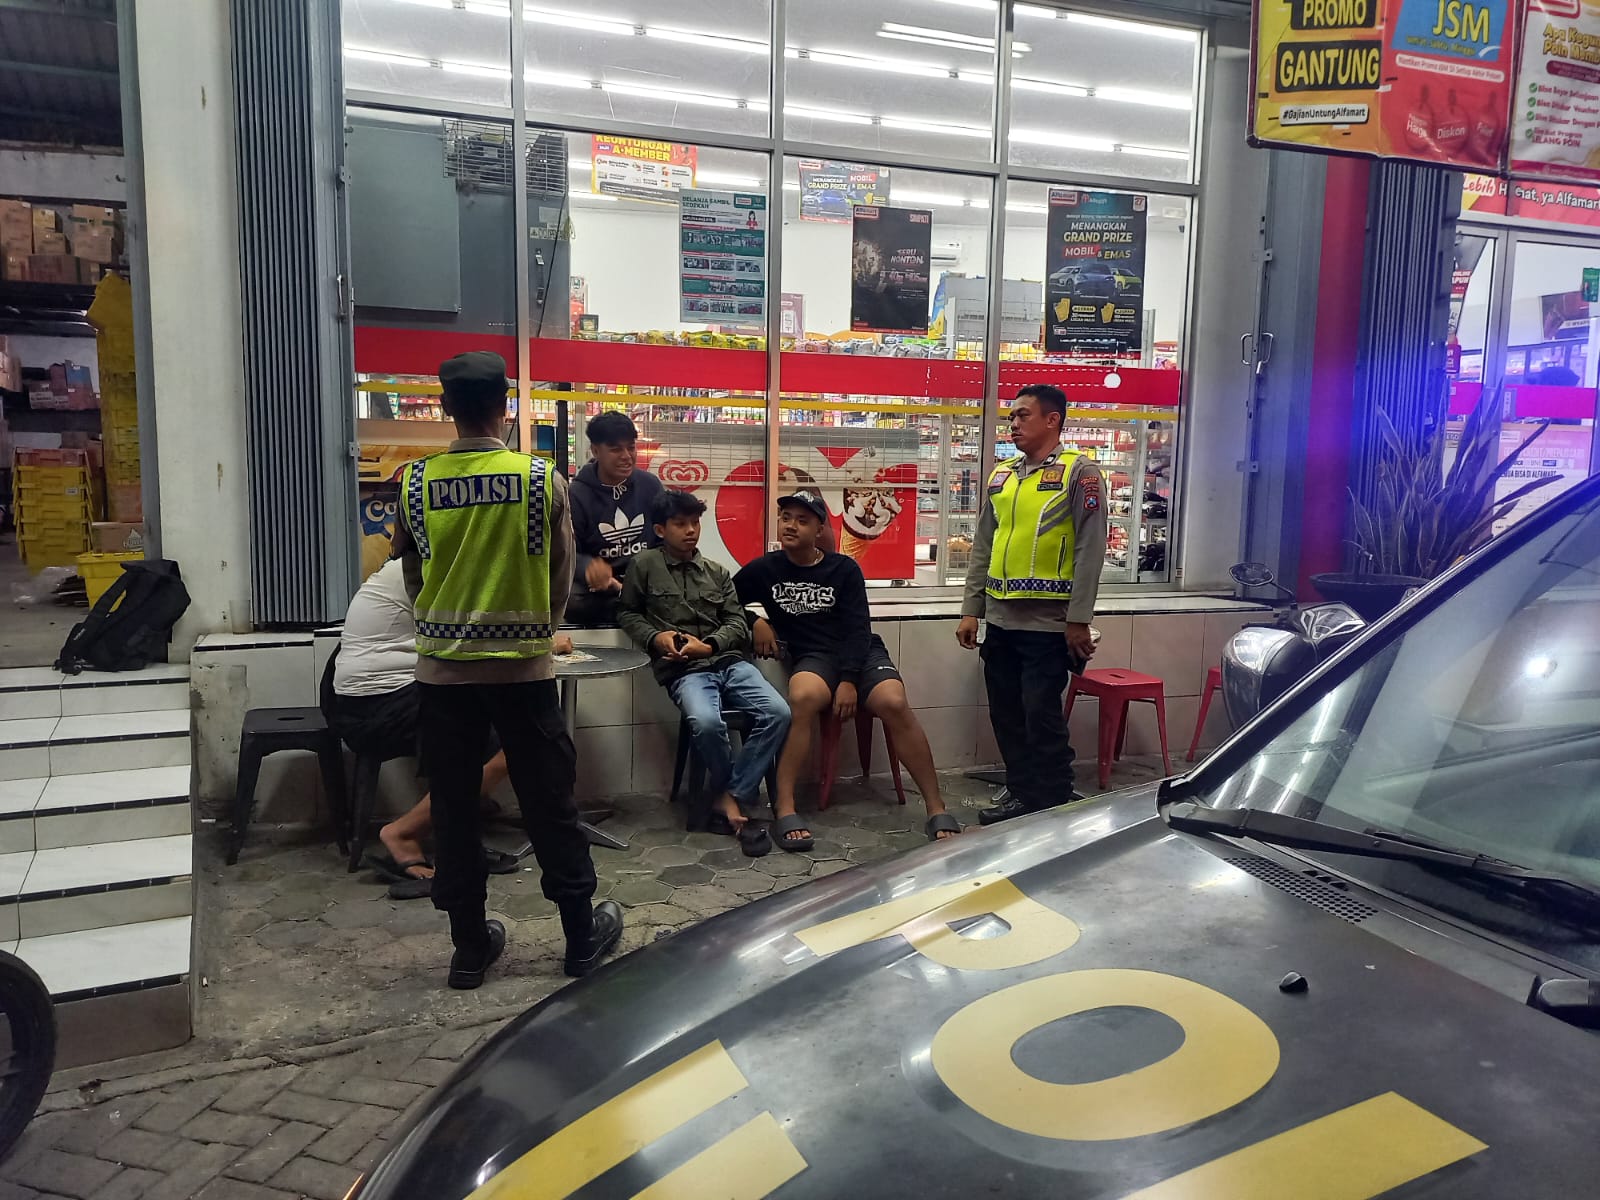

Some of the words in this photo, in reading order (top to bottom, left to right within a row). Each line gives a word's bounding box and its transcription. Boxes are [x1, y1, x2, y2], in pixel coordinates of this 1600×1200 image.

[1303, 0, 1367, 27] PROMO
[1432, 0, 1490, 44] JSM
[1543, 23, 1567, 43] Apa
[1543, 39, 1569, 57] Poin
[1280, 48, 1379, 87] GANTUNG
[1541, 192, 1555, 206] ya
[1071, 222, 1127, 231] MENANGKAN
[1063, 232, 1101, 242] GRAND
[1102, 232, 1133, 243] PRIZE
[1065, 246, 1096, 256] MOBIL
[1104, 249, 1131, 259] EMAS
[430, 475, 520, 508] POLISI
[600, 541, 648, 558] adidas
